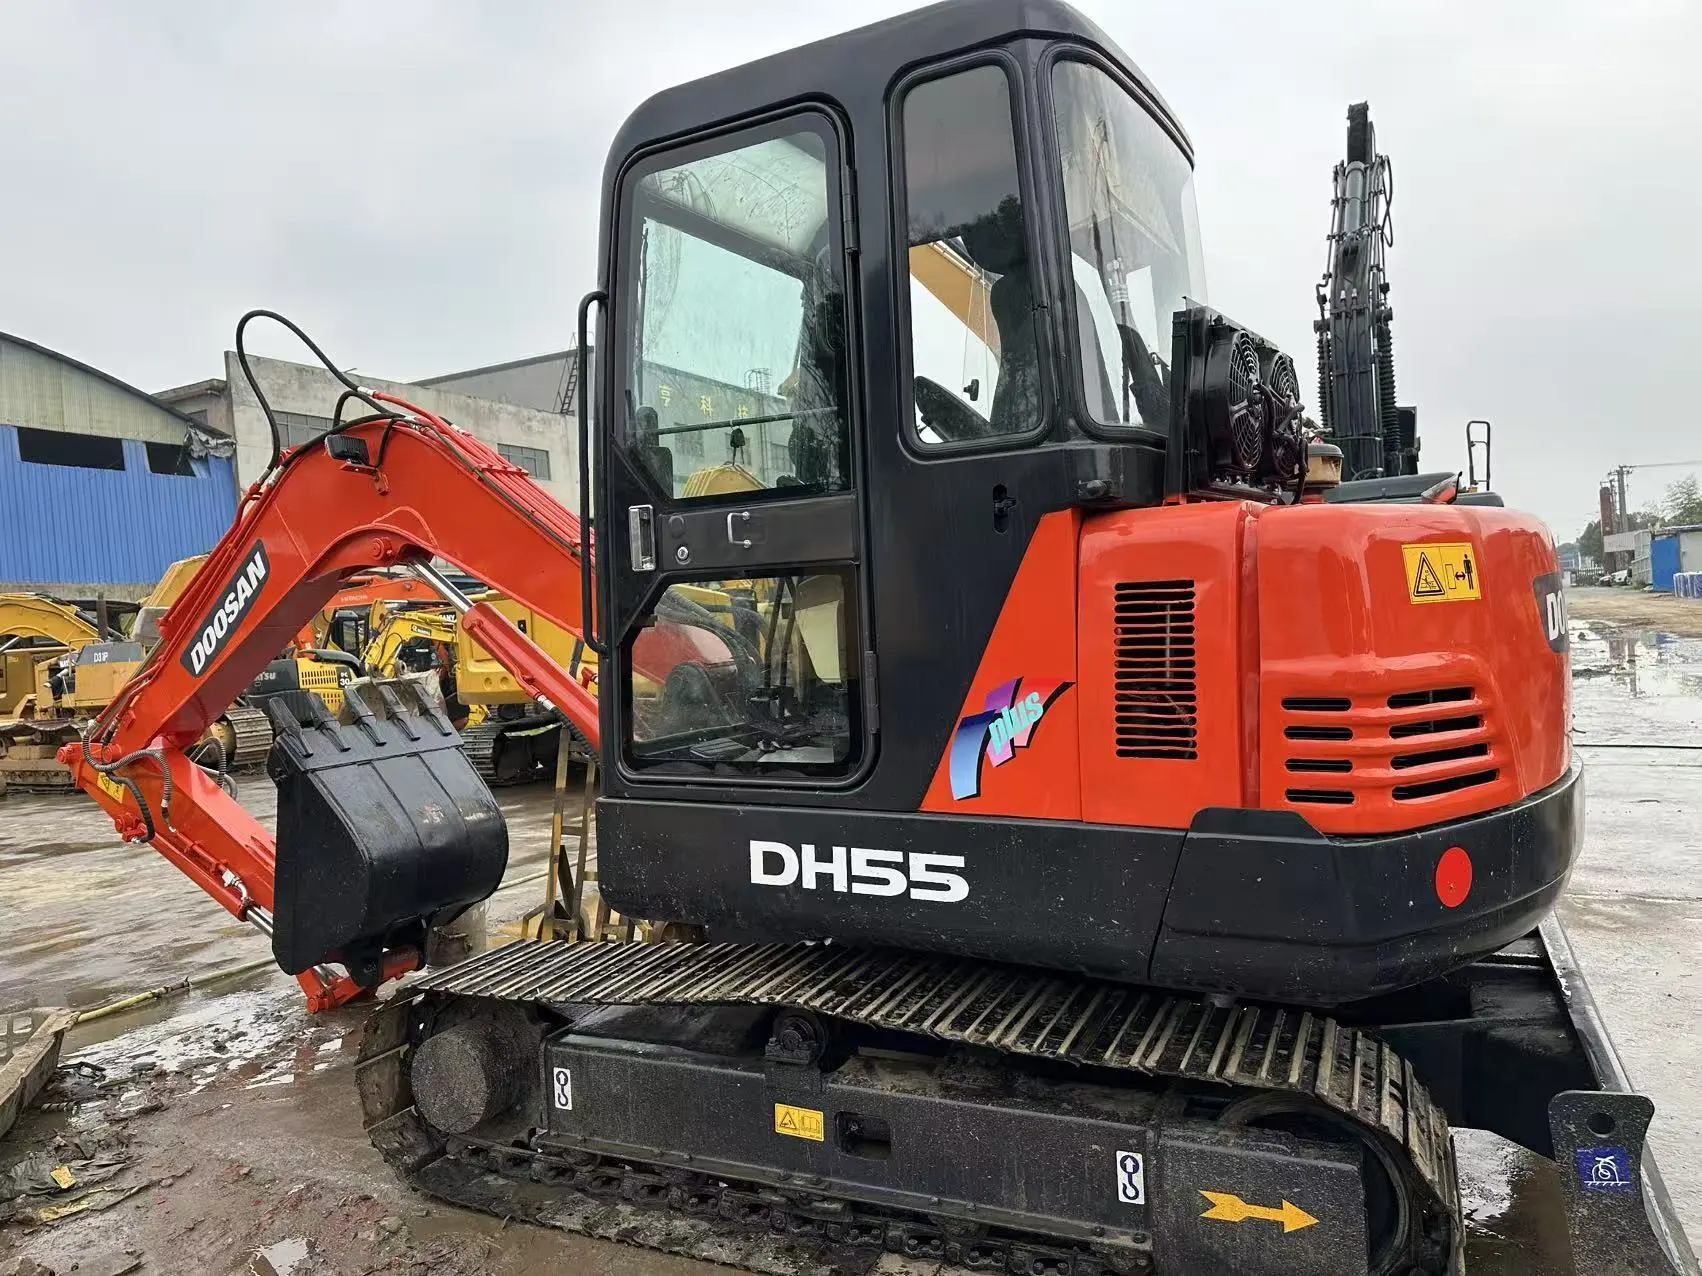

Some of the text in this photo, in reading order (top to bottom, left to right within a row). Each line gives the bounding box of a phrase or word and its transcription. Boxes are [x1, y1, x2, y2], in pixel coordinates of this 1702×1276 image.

[190, 551, 266, 675] DOOSAN
[1546, 590, 1569, 641] DO
[339, 678, 350, 686] 30
[988, 691, 1044, 755] plus
[749, 839, 970, 903] DH55
